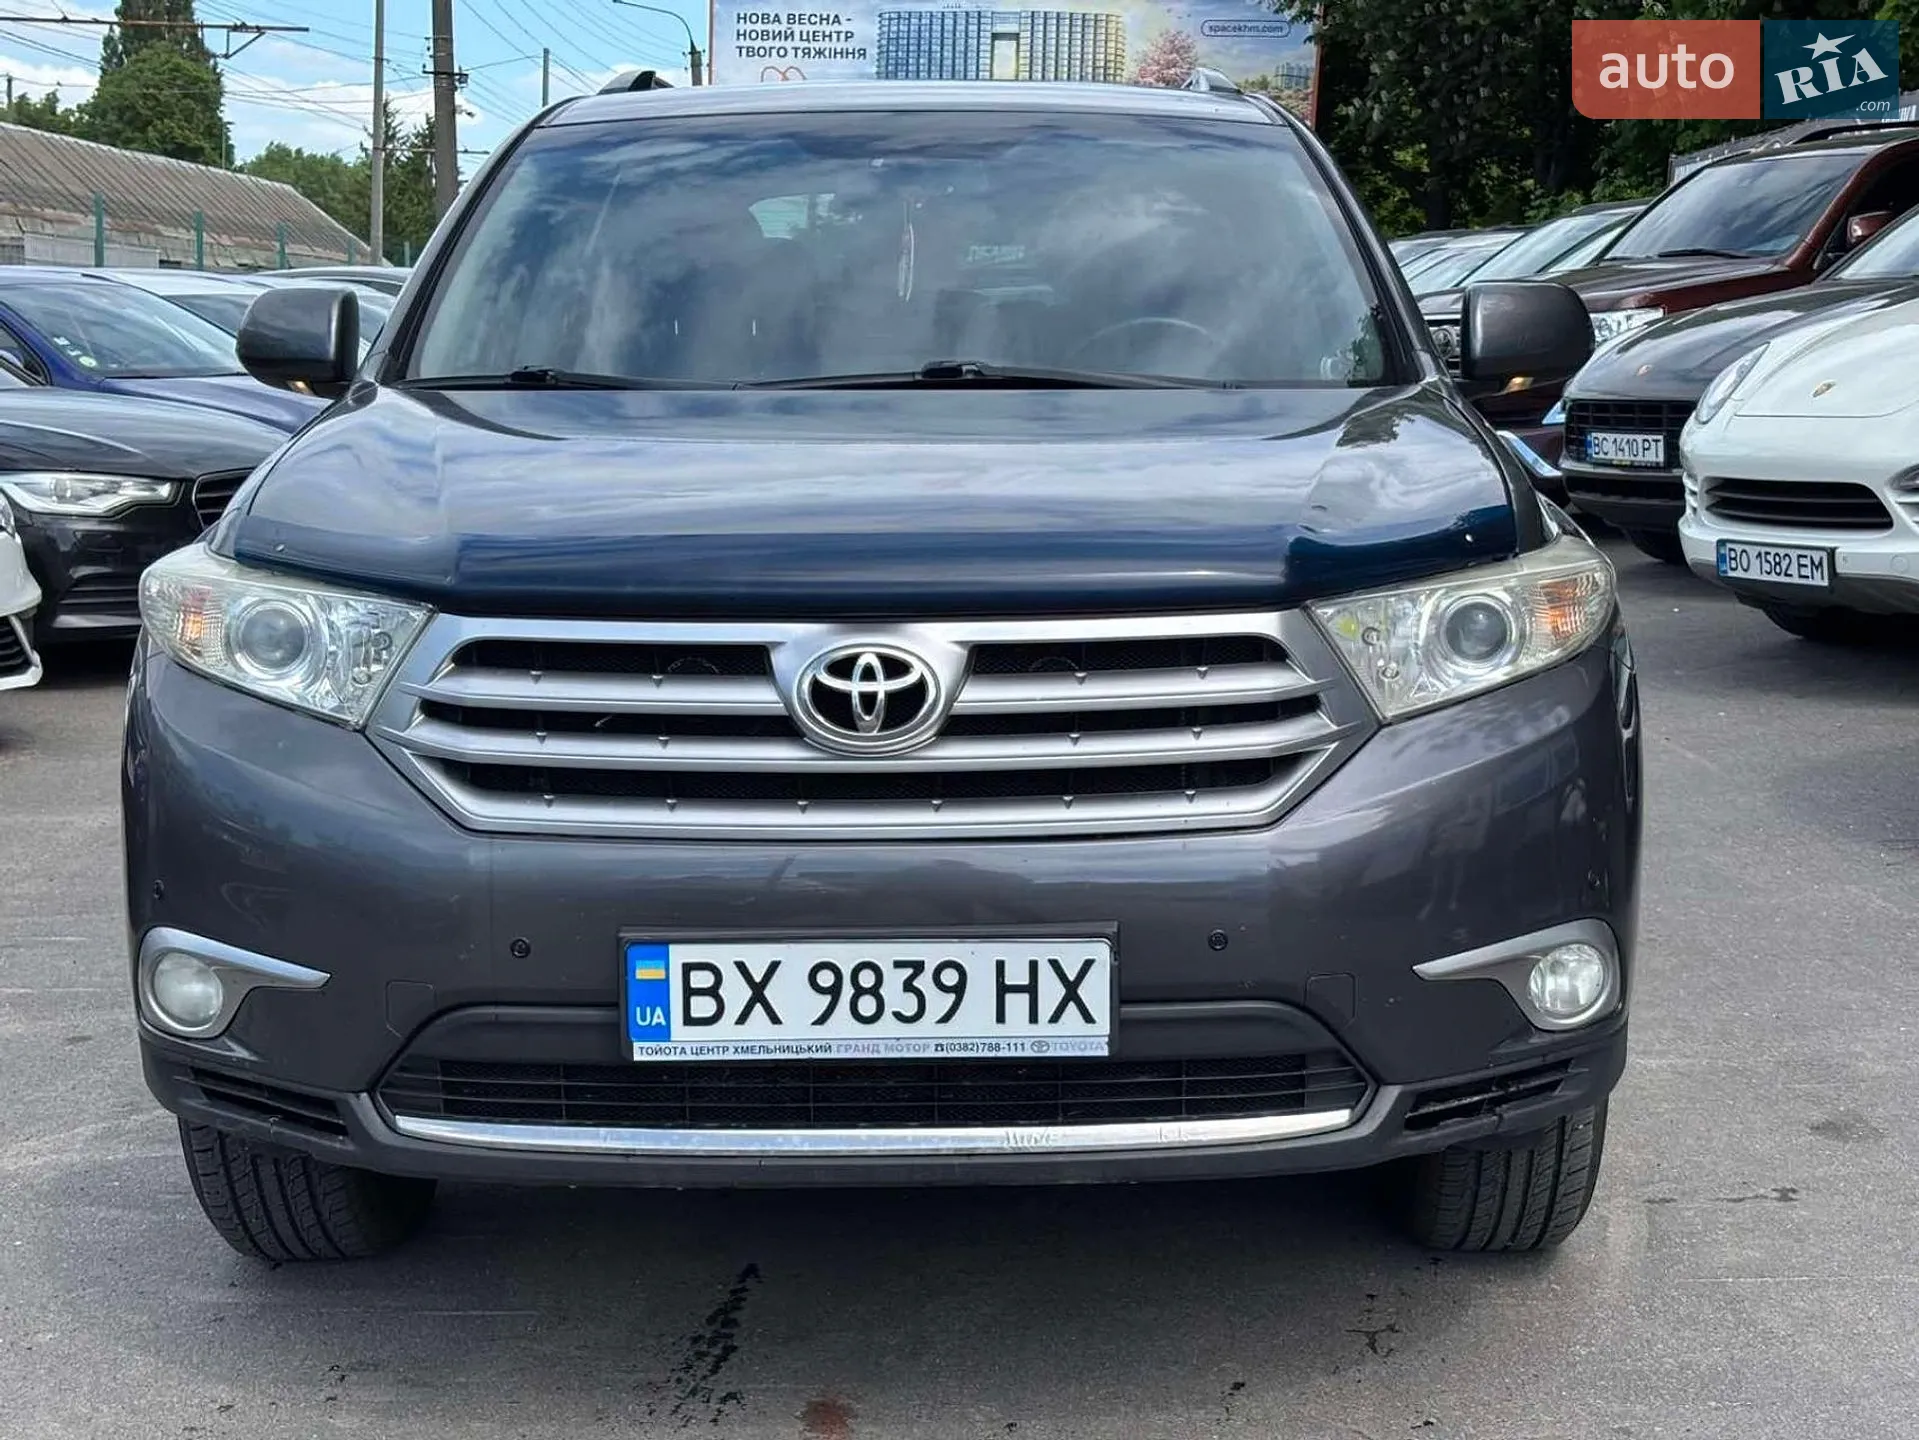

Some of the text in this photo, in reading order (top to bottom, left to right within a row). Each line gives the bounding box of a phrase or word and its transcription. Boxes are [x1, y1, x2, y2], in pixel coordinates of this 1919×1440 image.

[736, 12, 782, 25] НОВА
[787, 13, 842, 26] ВЕСНА
[736, 28, 855, 43] НОВИЙ ЦЕНТР
[735, 45, 867, 60] ТВОГО ТЯЖІННЯ
[1593, 436, 1662, 459] BC 1410 PT
[1728, 547, 1825, 581] BO 1582 EM
[681, 958, 1097, 1027] BX 9839 HX
[635, 1006, 667, 1027] UA
[638, 1044, 688, 1057] ТОЙОТА
[690, 1045, 730, 1057] ЦЕНТР
[732, 1043, 833, 1056] ХМЕЛЬНИЦЬКИЙ
[836, 1043, 880, 1055] ГРАНД
[884, 1042, 931, 1054] МОТОР
[1053, 1041, 1105, 1052] TOYOTA
